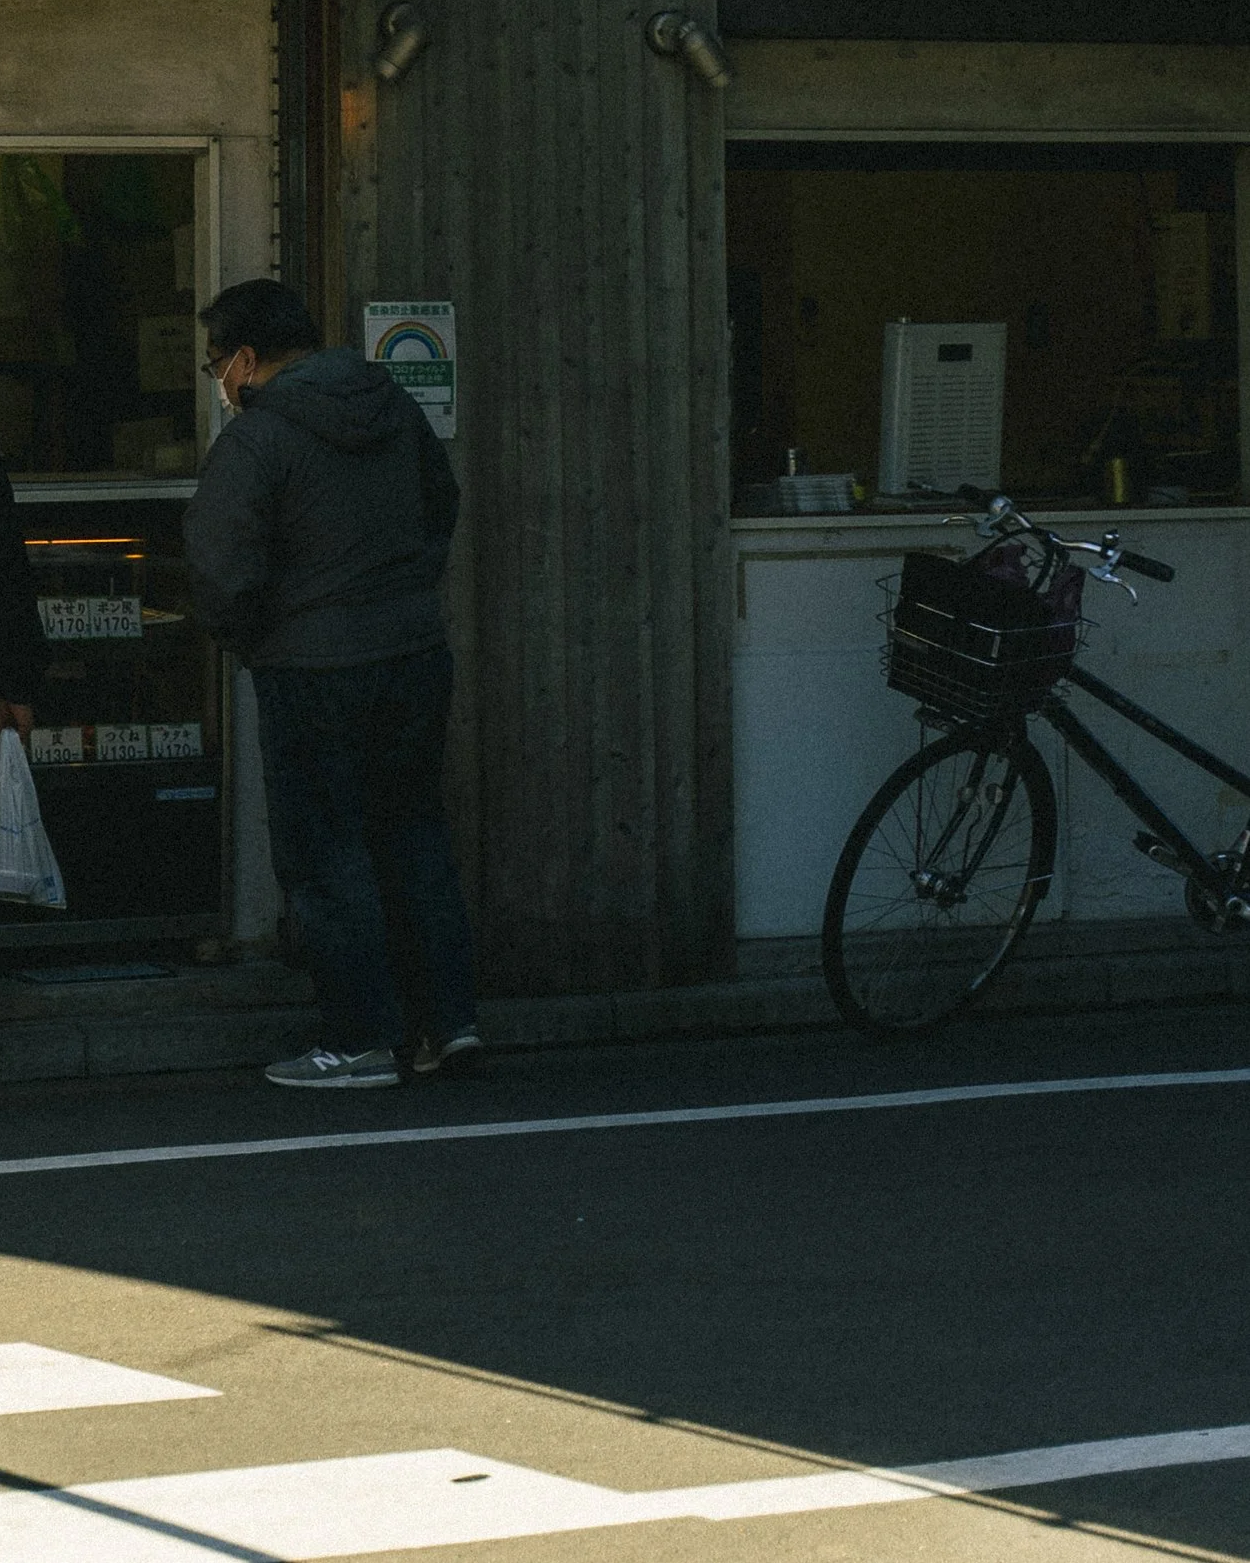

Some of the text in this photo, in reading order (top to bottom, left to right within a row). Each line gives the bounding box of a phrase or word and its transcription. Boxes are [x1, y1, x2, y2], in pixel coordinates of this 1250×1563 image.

[52, 603, 85, 615] せせり
[105, 730, 140, 742] つくね
